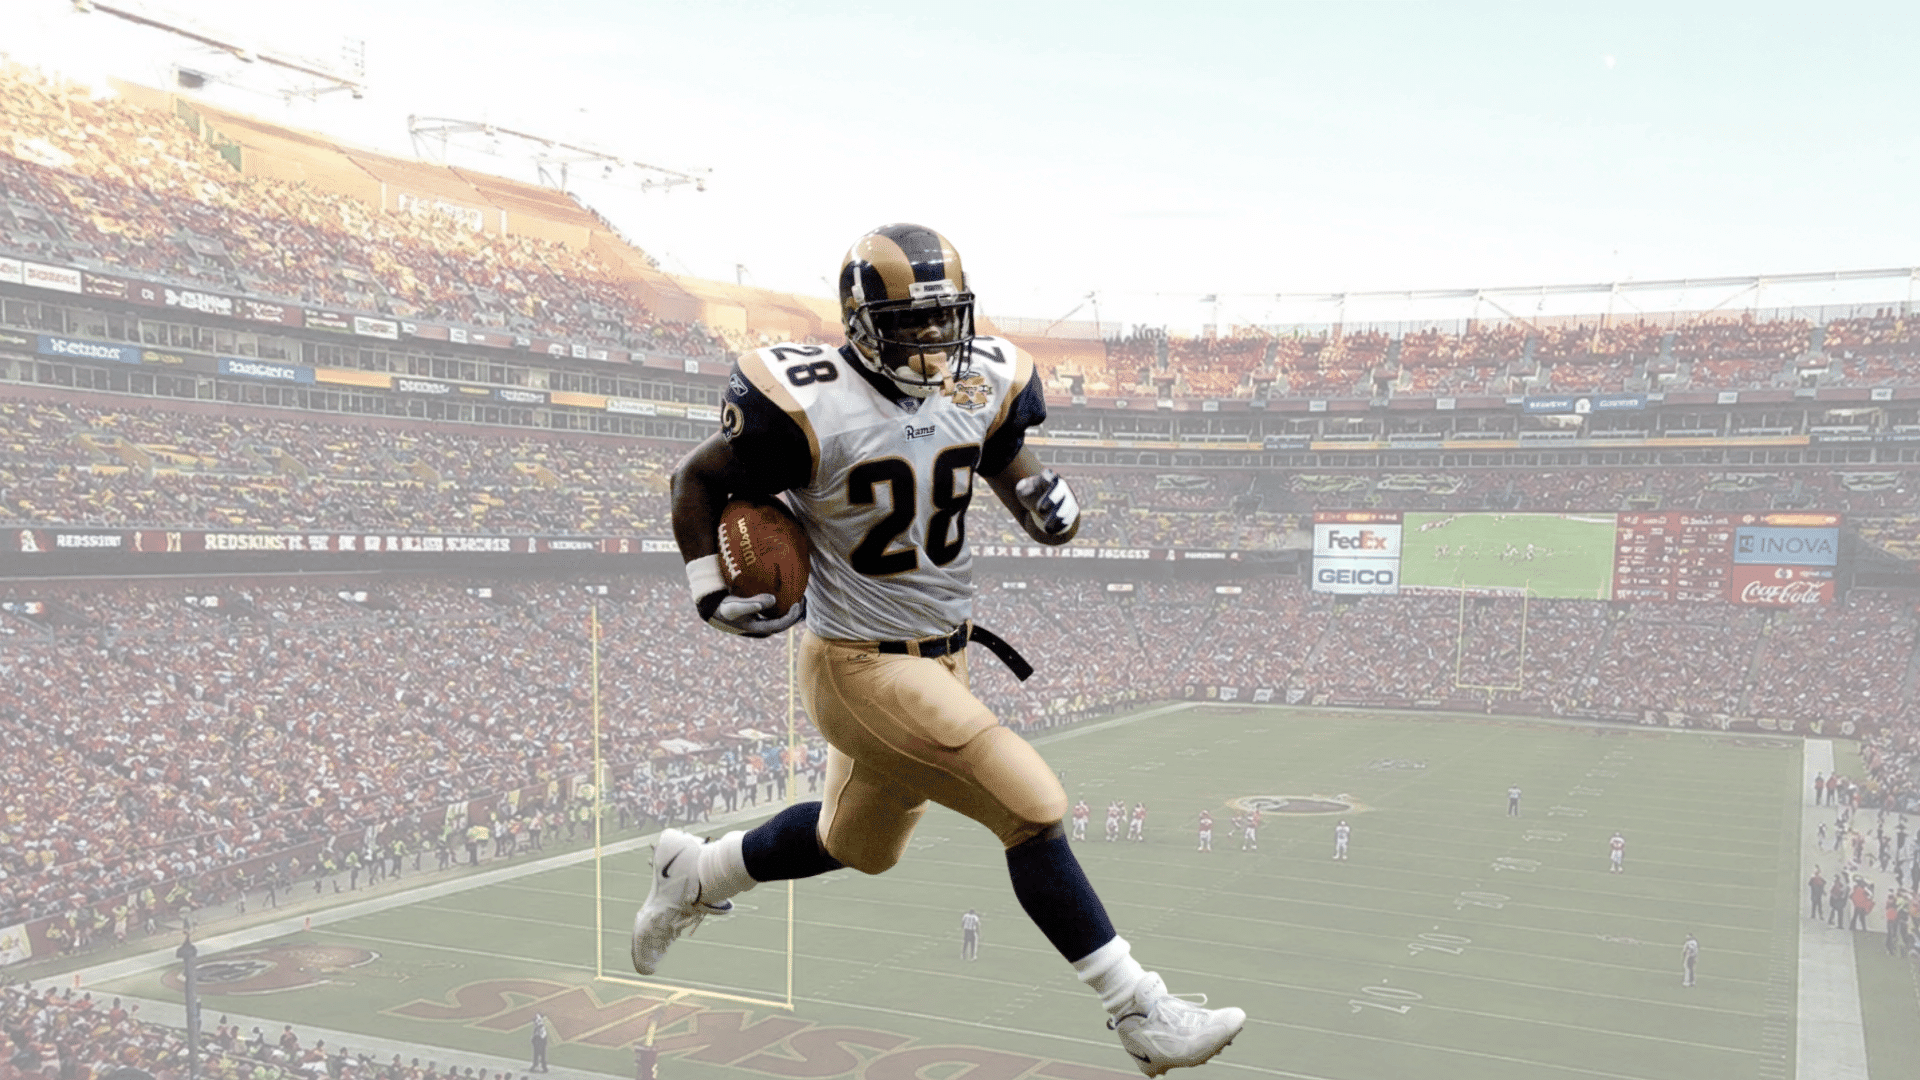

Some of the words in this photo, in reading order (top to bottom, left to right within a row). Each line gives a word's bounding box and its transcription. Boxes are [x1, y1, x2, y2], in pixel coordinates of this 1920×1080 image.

[769, 346, 838, 388] 28
[904, 424, 936, 440] Rams
[848, 442, 981, 577] 28
[737, 517, 757, 567] Wilson
[1328, 530, 1387, 551] FedEx
[1760, 537, 1833, 555] INOVA
[1318, 568, 1394, 586] GEICO
